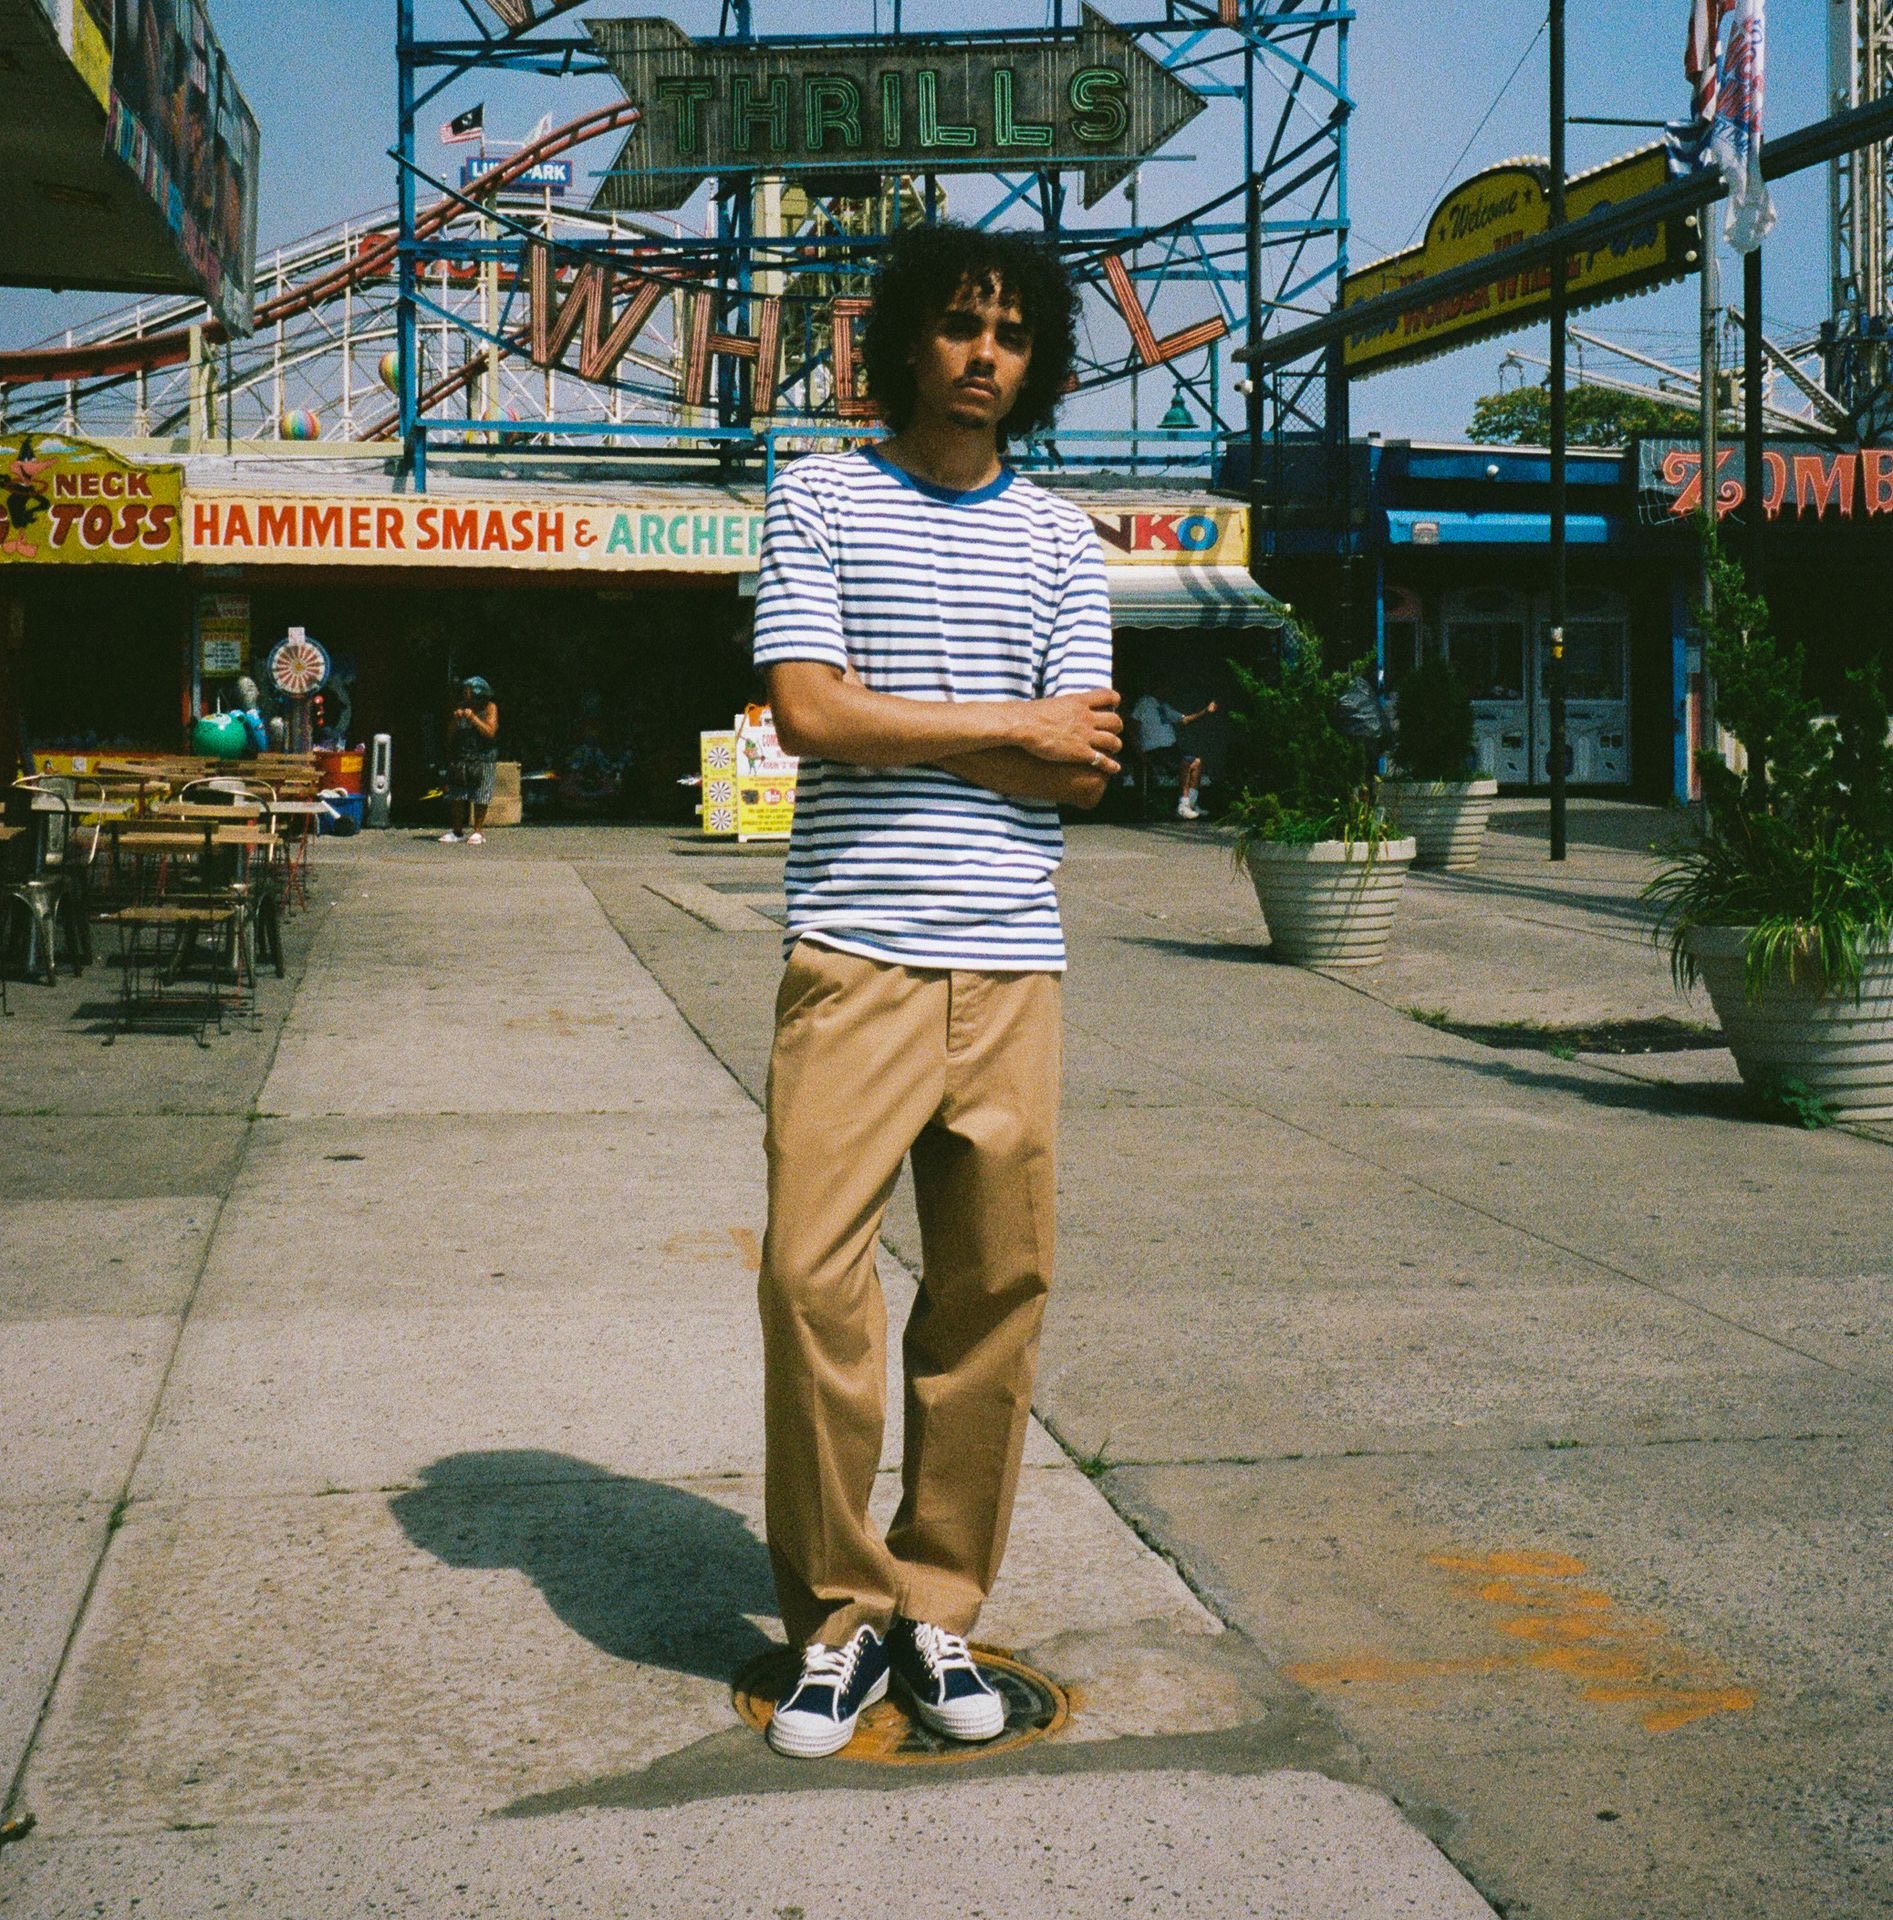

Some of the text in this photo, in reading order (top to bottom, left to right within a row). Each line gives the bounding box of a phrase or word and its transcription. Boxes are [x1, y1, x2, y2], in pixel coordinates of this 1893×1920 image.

[656, 67, 1129, 156] THRILLS
[1449, 191, 1518, 240] Welcome
[527, 238, 1229, 418] WHEL
[54, 471, 153, 499] NECK
[50, 503, 177, 549] TOSS
[193, 503, 407, 549] HAMMER
[415, 507, 564, 552] SMASH
[573, 518, 598, 548] &
